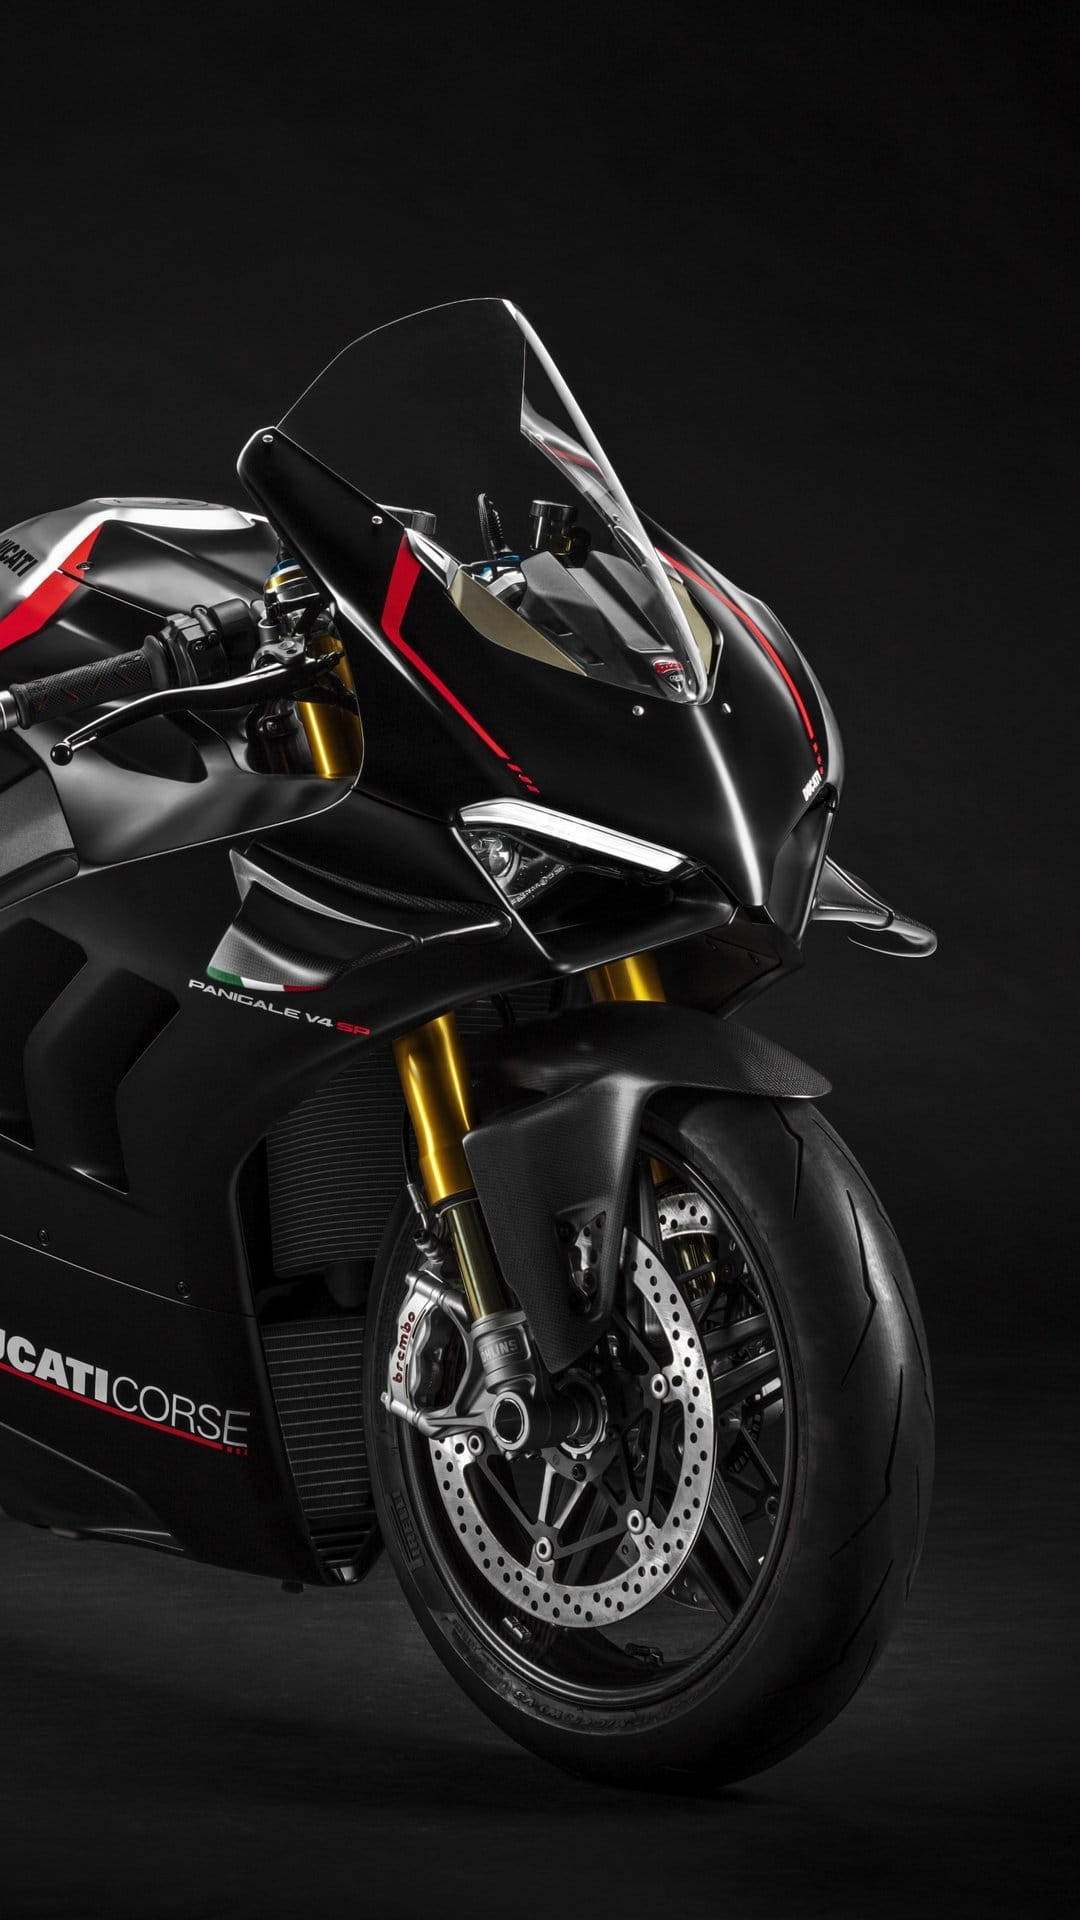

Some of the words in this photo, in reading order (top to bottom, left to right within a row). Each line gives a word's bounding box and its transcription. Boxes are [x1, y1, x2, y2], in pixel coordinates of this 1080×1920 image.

[0, 538, 38, 577] UCATI
[188, 979, 301, 1020] PANIGALE
[305, 1012, 333, 1027] V4
[392, 1311, 416, 1384] brembo
[0, 1329, 109, 1404] CATI
[112, 1376, 250, 1448] CORSE
